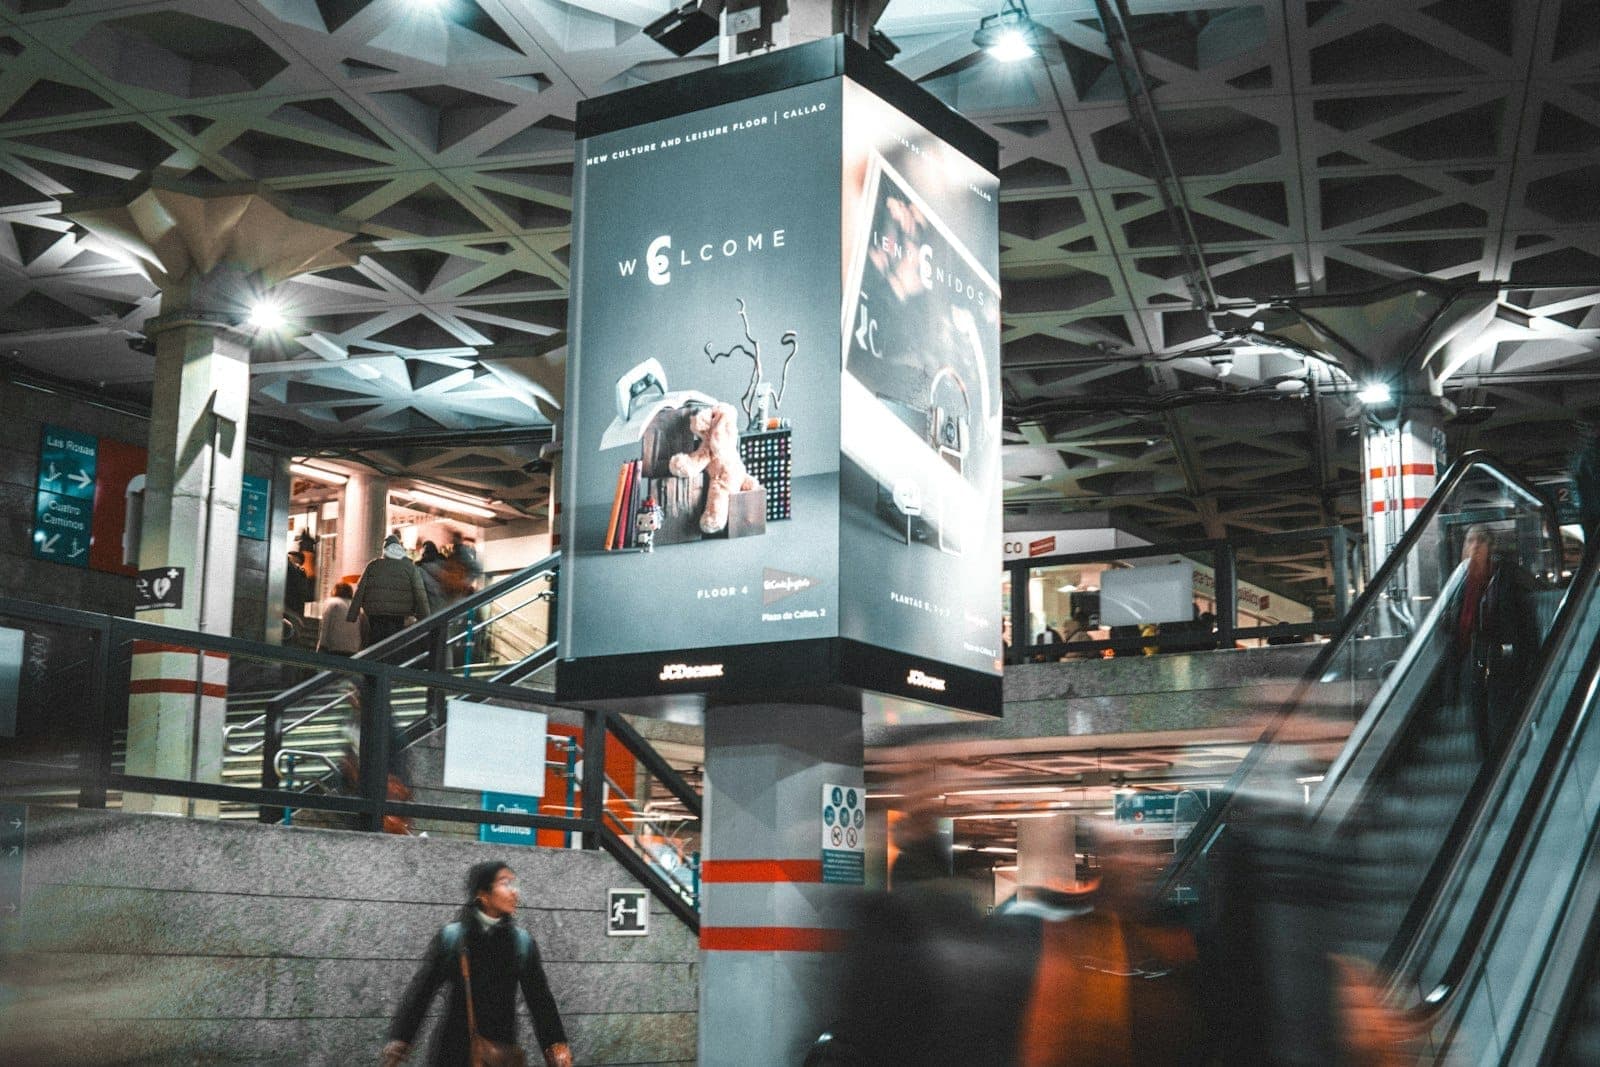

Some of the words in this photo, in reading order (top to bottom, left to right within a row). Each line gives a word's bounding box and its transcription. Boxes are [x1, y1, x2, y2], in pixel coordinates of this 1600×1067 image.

[586, 154, 608, 166] NEW
[611, 143, 656, 160] CULTURE
[660, 137, 682, 148] AND
[685, 125, 729, 143] LEISURE
[732, 116, 768, 132] FLOOR
[782, 102, 827, 120] CALLAO
[618, 229, 786, 286] WELCOME
[873, 231, 985, 306] IENVENIDOS
[46, 434, 65, 450] Las
[66, 439, 96, 457] Rosas
[50, 500, 82, 516] Cuatro
[42, 512, 85, 531] Caminos
[696, 586, 737, 600] FLOOR
[740, 585, 749, 596] 4
